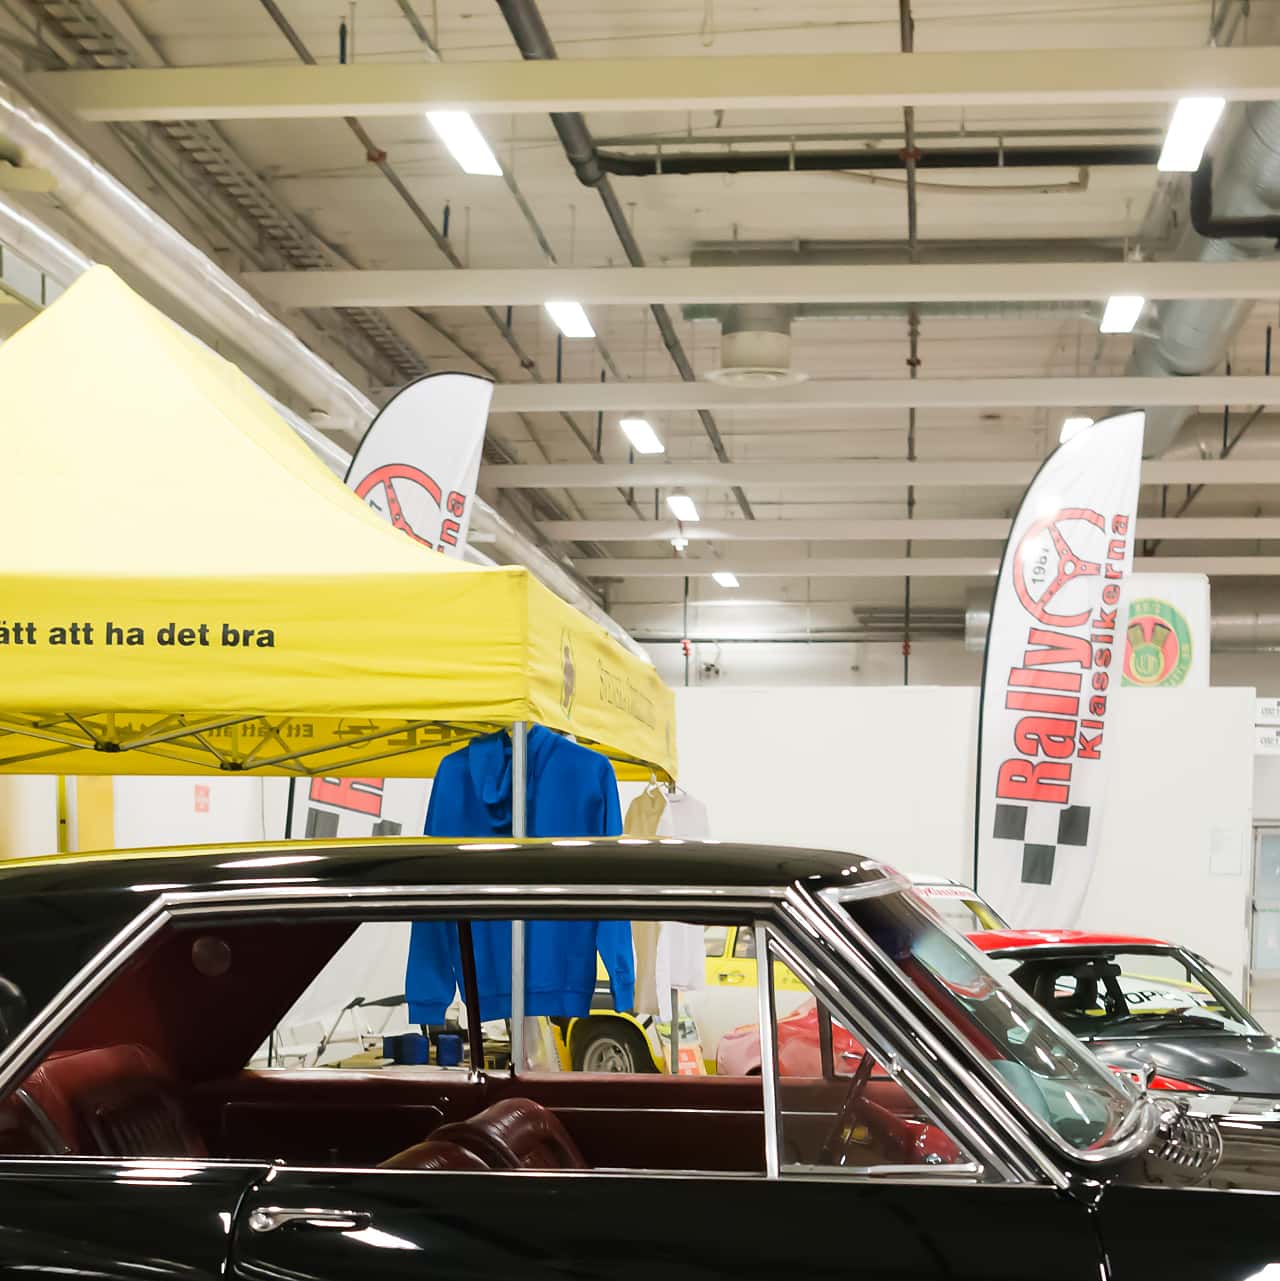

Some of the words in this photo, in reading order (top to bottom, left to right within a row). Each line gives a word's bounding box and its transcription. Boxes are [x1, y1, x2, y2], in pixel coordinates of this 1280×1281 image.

[48, 622, 94, 646] att
[105, 622, 145, 646] ha
[156, 622, 210, 647] det
[221, 623, 275, 648] bra
[996, 628, 1094, 804] Rally
[1077, 513, 1130, 760] Klassikerna
